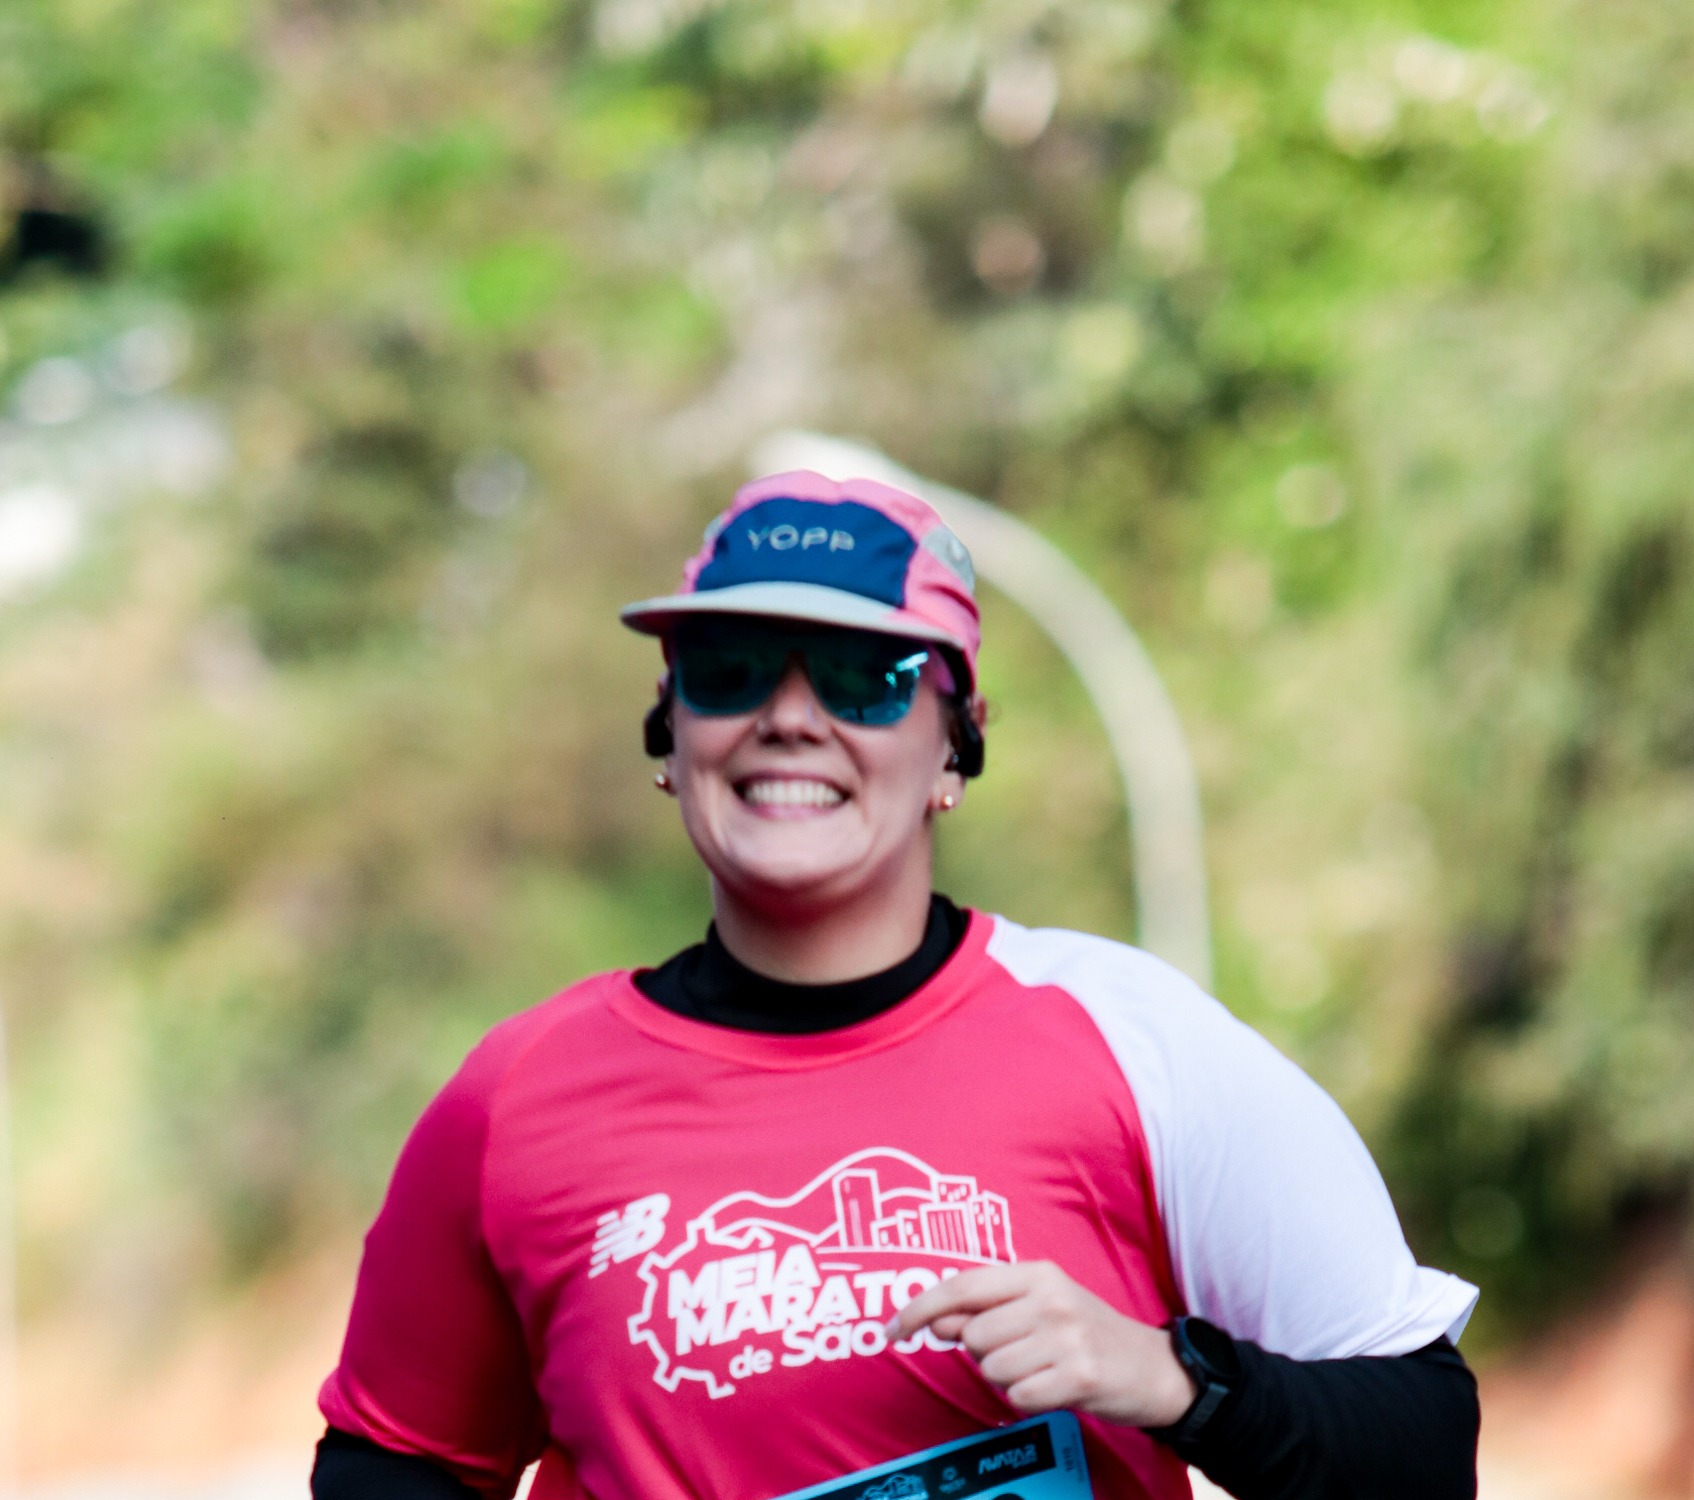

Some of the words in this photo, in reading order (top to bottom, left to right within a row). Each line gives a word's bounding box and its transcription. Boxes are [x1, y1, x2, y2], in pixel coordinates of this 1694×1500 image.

[667, 1243, 822, 1319] MEIA
[675, 1267, 960, 1357] MARATO
[729, 1345, 774, 1380] de
[780, 1311, 888, 1368] São
